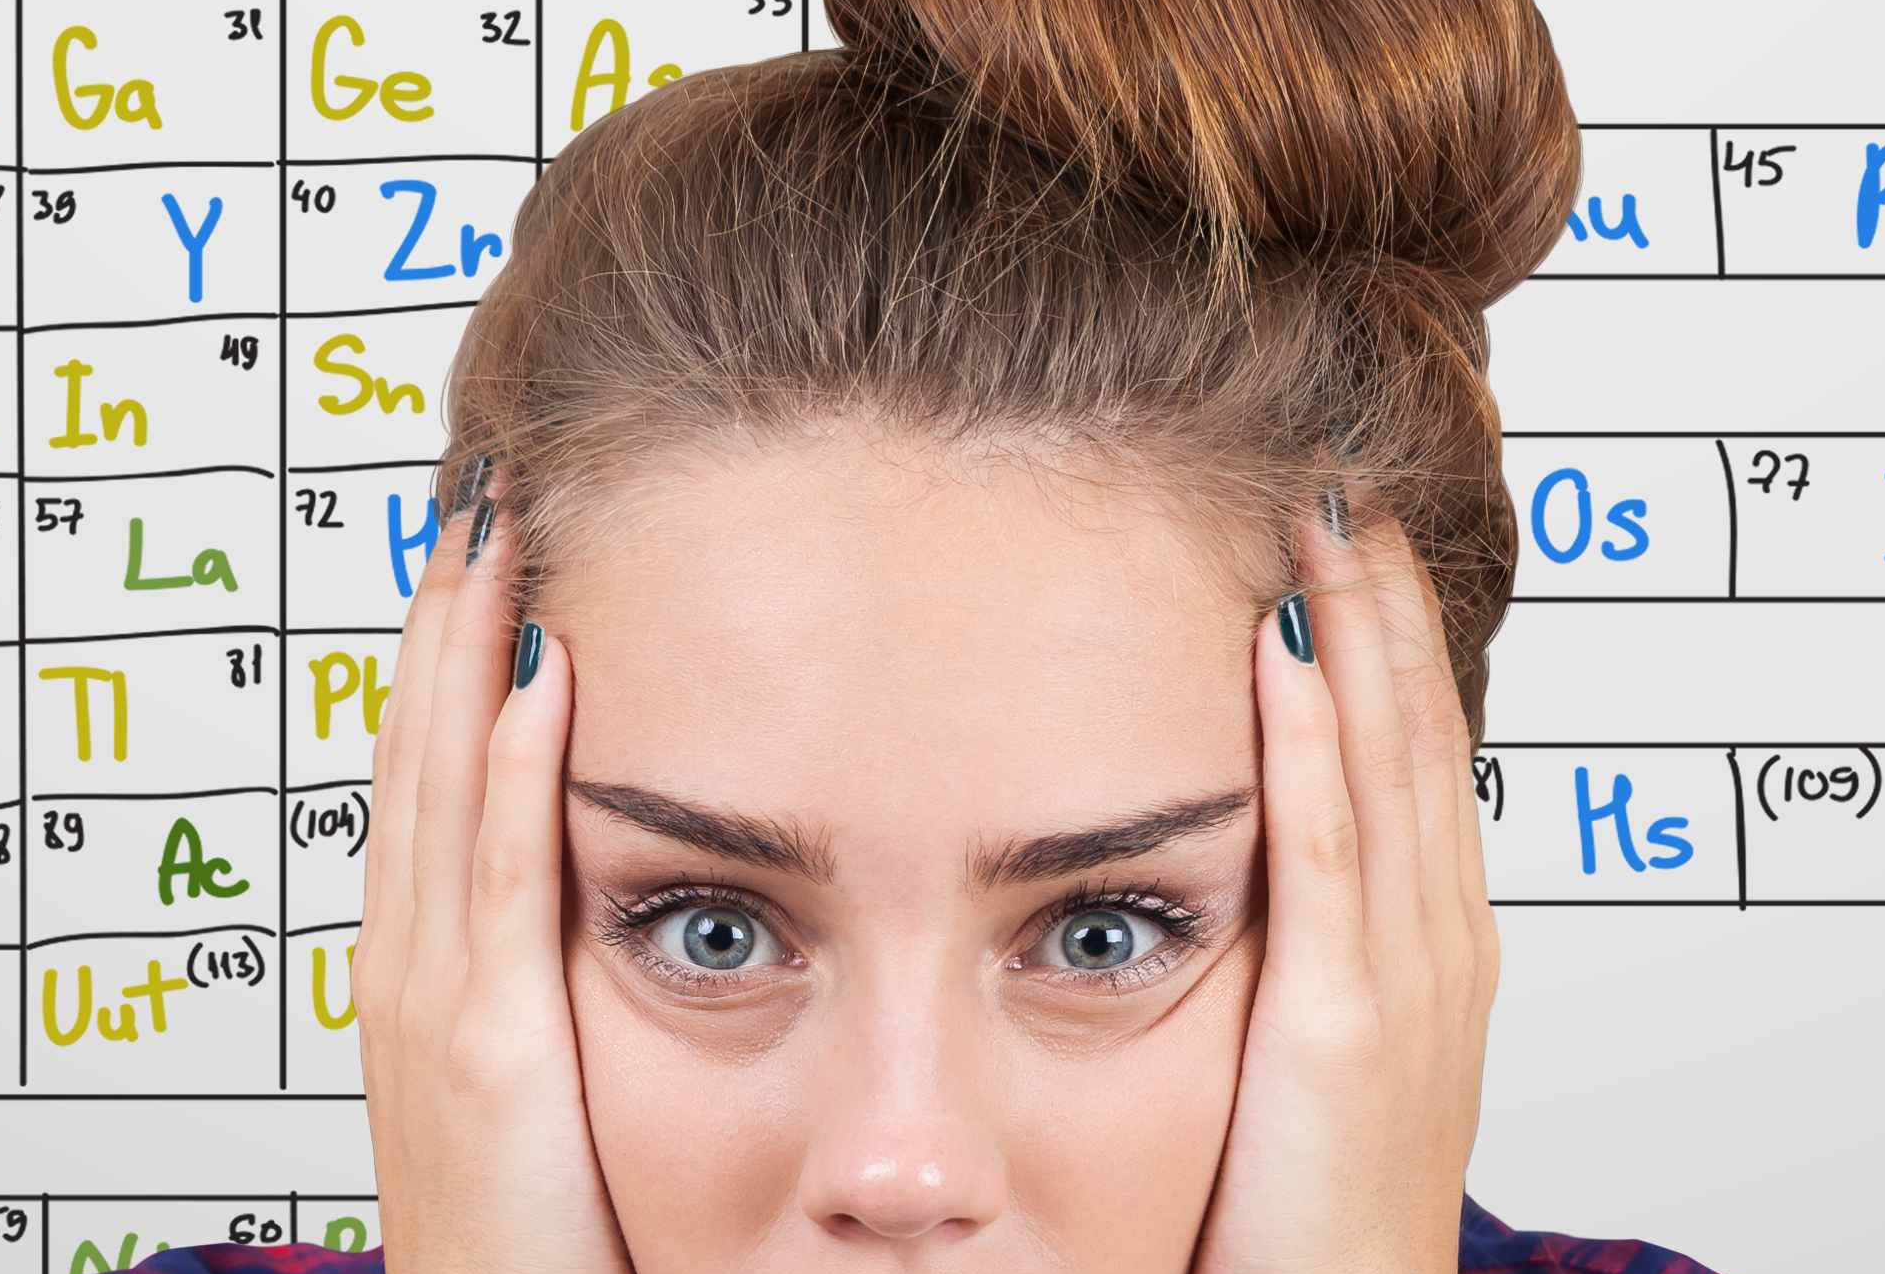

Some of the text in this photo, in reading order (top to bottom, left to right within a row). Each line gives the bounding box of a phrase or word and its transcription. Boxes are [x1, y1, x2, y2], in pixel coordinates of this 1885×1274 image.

[52, 8, 263, 131] Ga 31
[310, 10, 531, 123] Ge 32
[1723, 140, 1797, 188] 45
[31, 190, 223, 304] 39 Y
[291, 179, 503, 282] 40 Zr
[49, 358, 148, 449] In
[313, 333, 426, 416] Sn
[295, 488, 344, 528] 72
[1530, 468, 1650, 565] Os
[1747, 450, 1810, 501] 77
[35, 497, 238, 591] 57 La
[38, 666, 129, 763] Tl
[1574, 766, 1694, 876] Hs
[1758, 746, 1883, 822] (109)
[158, 817, 250, 906] Ac
[41, 959, 189, 1047] Uut
